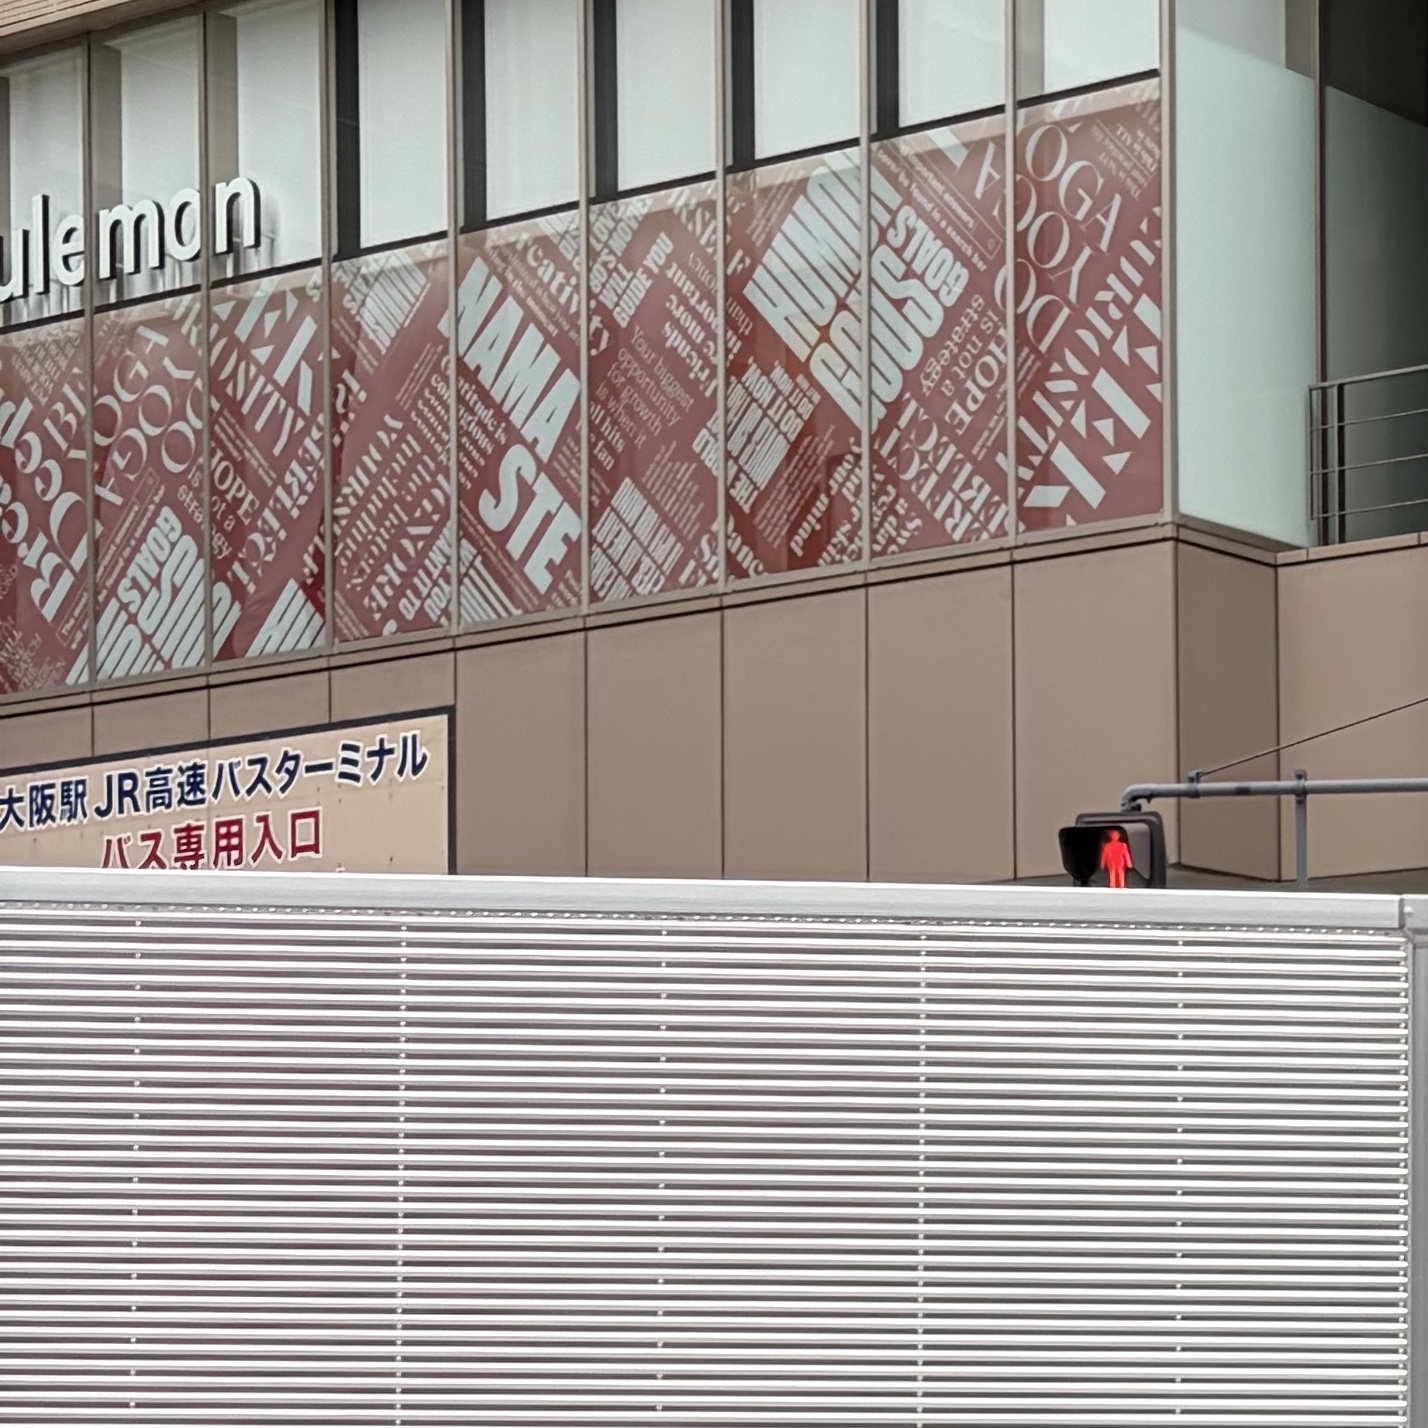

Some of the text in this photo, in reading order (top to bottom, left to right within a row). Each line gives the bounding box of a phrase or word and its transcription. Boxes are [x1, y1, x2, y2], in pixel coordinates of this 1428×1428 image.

[1017, 118, 1132, 256] OGA
[887, 205, 969, 307] GOALS
[944, 224, 975, 258] search
[596, 262, 635, 310] WILL
[608, 230, 677, 329] GUIDE YOU
[662, 293, 707, 345] more
[626, 325, 697, 416] Your biggest
[950, 335, 988, 382] not
[606, 363, 664, 438] for growth
[613, 347, 681, 429] opportunity
[766, 394, 788, 423] IT
[788, 387, 803, 407] IT
[795, 395, 814, 421] DO
[599, 419, 628, 453] hits
[603, 394, 640, 437] when
[777, 406, 805, 442] DO
[590, 439, 619, 471] fan
[729, 471, 760, 514] THE
[478, 443, 581, 595] STE
[785, 492, 836, 558] mind
[101, 806, 324, 871] バス専用入口
